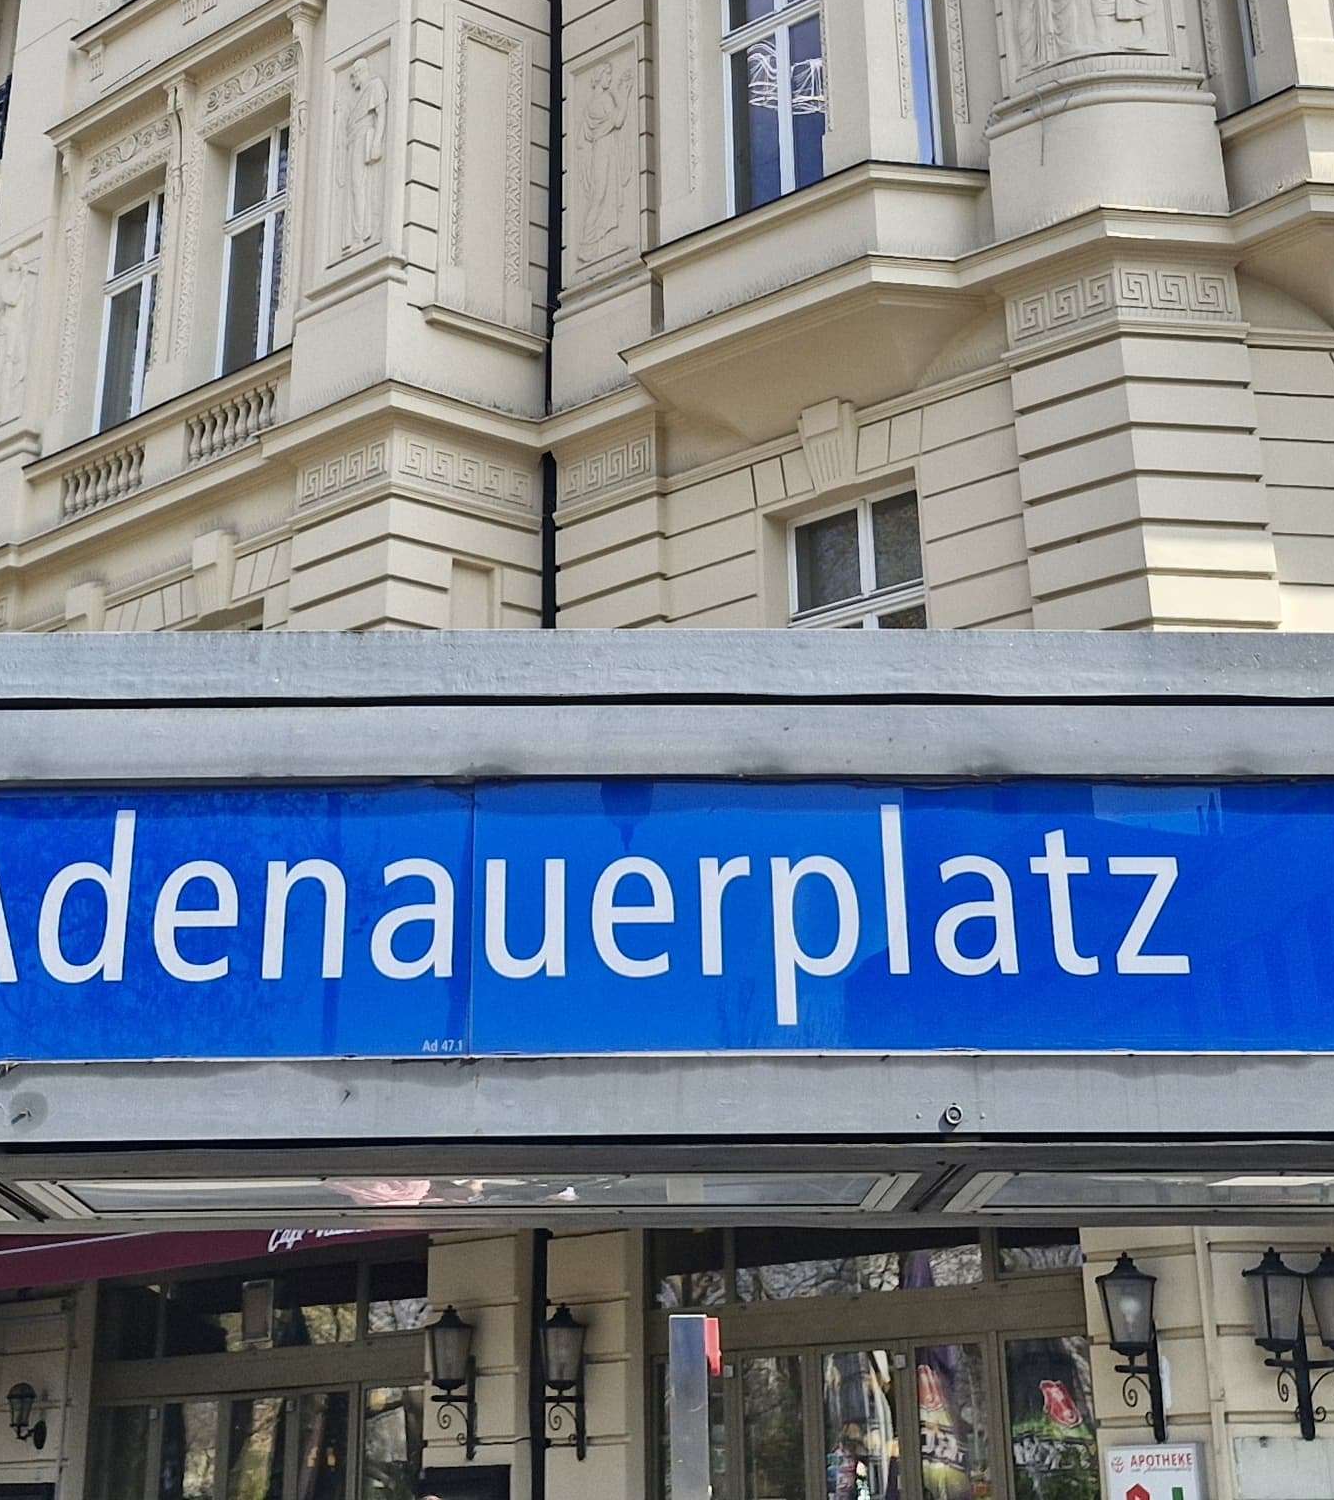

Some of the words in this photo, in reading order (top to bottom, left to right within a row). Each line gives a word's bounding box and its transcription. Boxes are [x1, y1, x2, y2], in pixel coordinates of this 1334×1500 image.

[421, 1039, 438, 1052] Ad
[441, 1039, 463, 1052] 47.1
[1130, 1452, 1194, 1468] APOTHEKE
